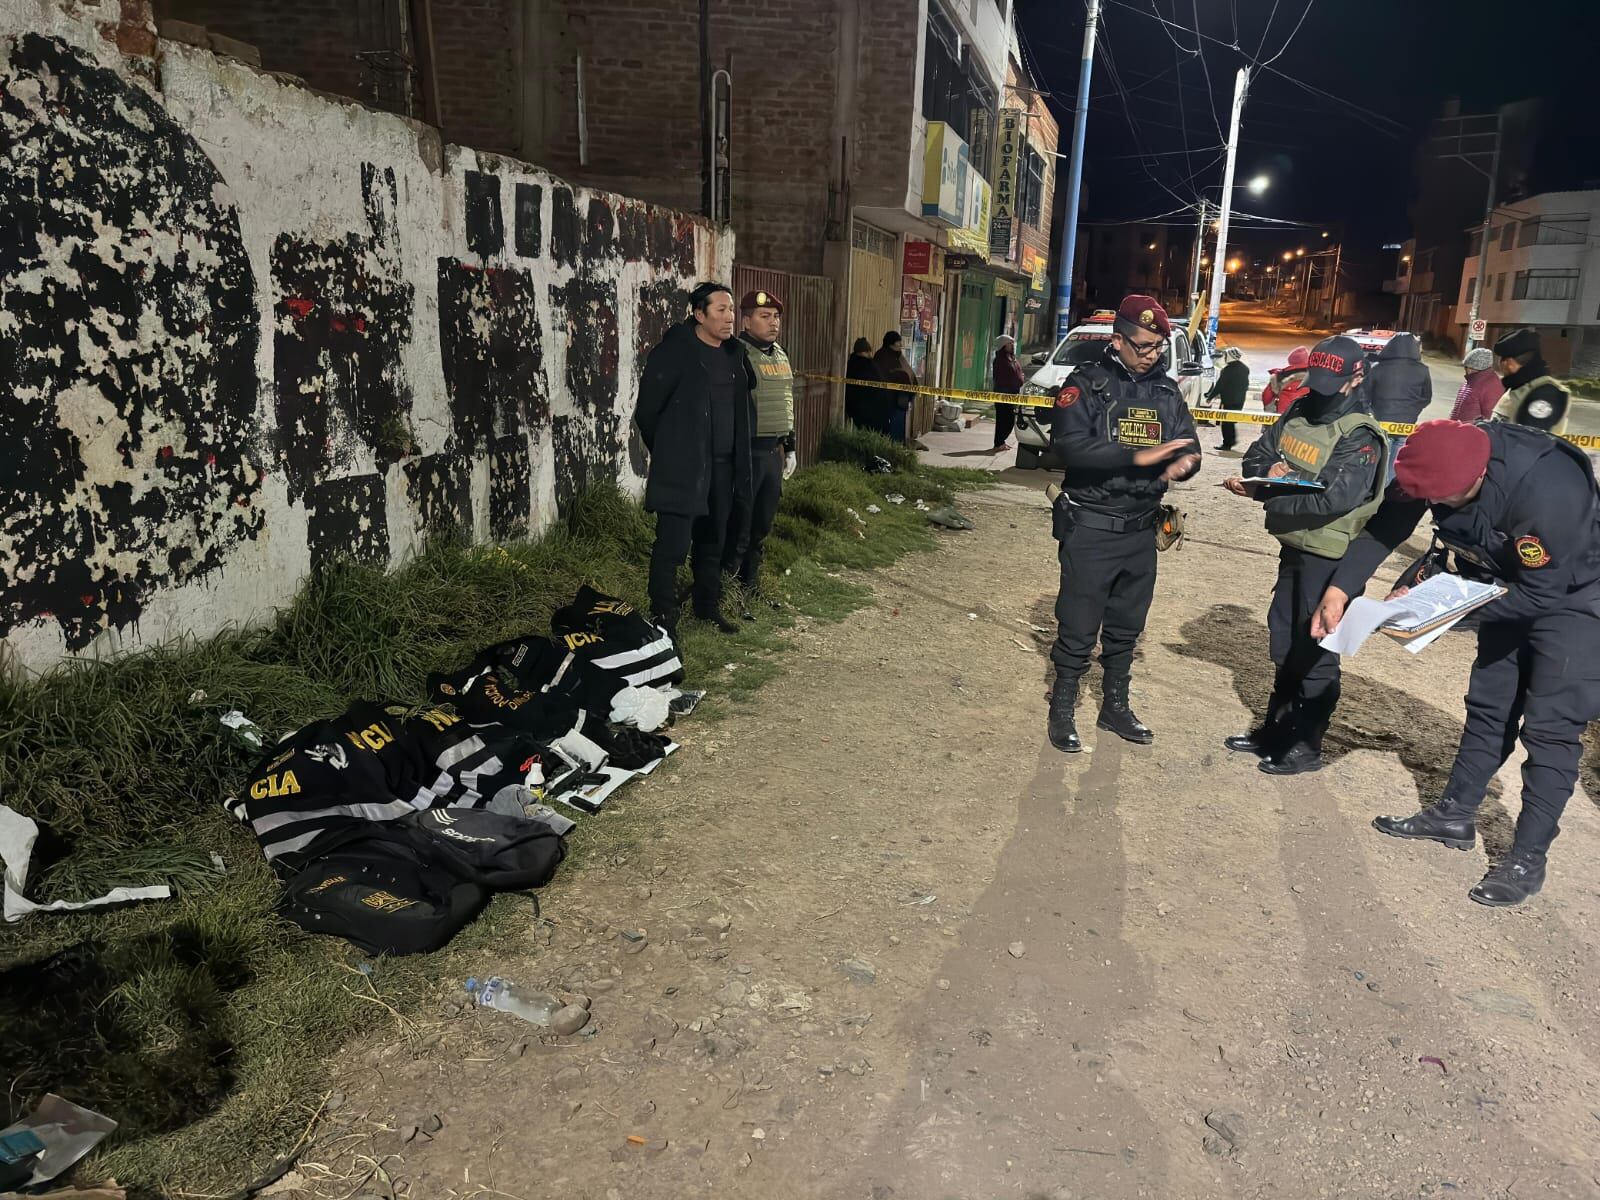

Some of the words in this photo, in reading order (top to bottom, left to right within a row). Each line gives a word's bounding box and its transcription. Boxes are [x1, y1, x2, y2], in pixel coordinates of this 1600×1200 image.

[997, 118, 1015, 217] BIOFARMA
[1120, 422, 1148, 438] POLICIA
[1280, 433, 1320, 465] POLICIA
[250, 769, 301, 800] CIA
